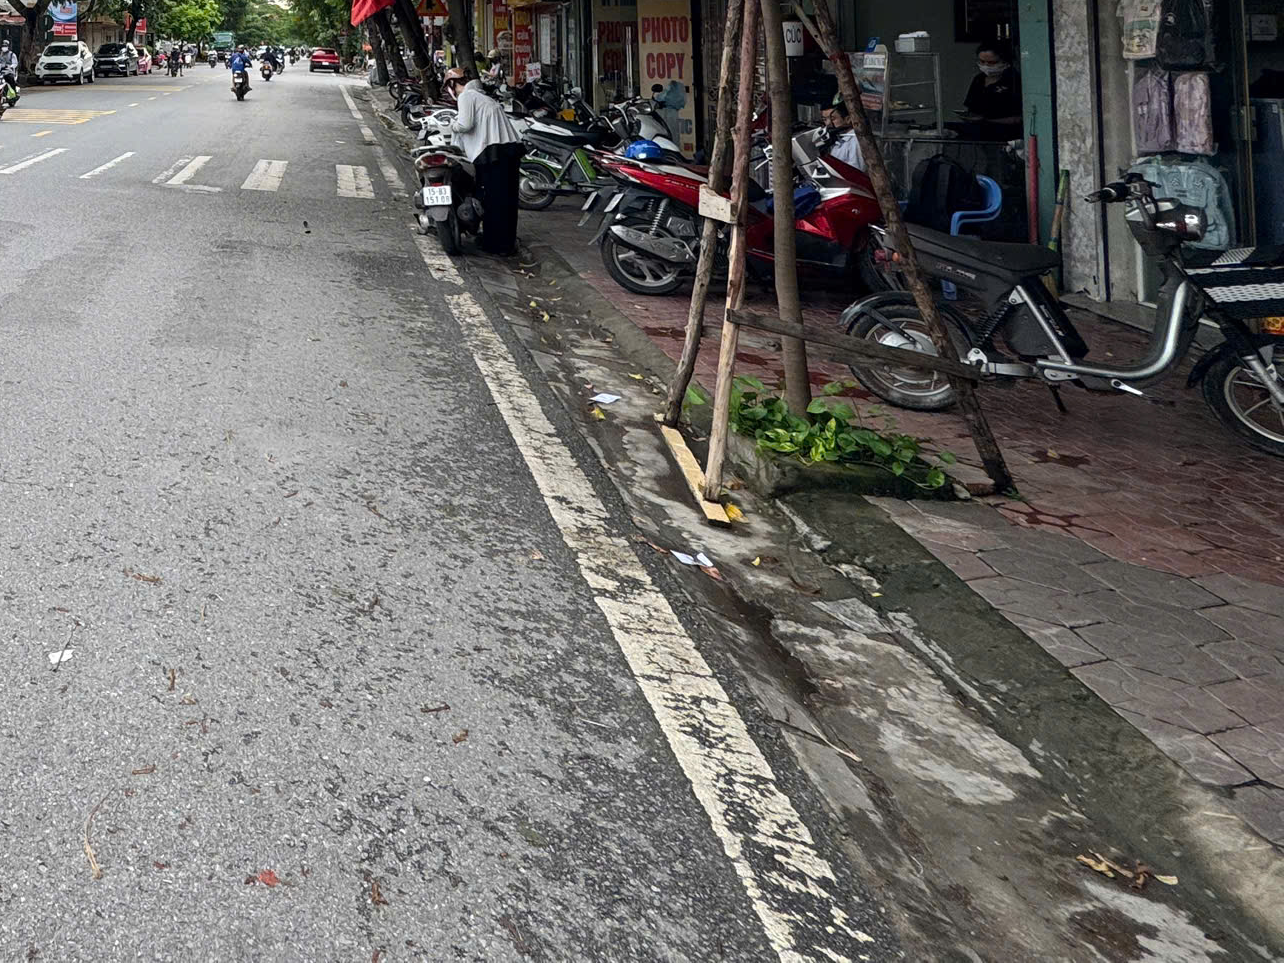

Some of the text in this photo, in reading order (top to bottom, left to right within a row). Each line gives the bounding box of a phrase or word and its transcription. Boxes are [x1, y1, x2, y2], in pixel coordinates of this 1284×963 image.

[642, 16, 689, 44] PHOTO
[785, 25, 802, 43] CÚC
[646, 52, 685, 79] COPY
